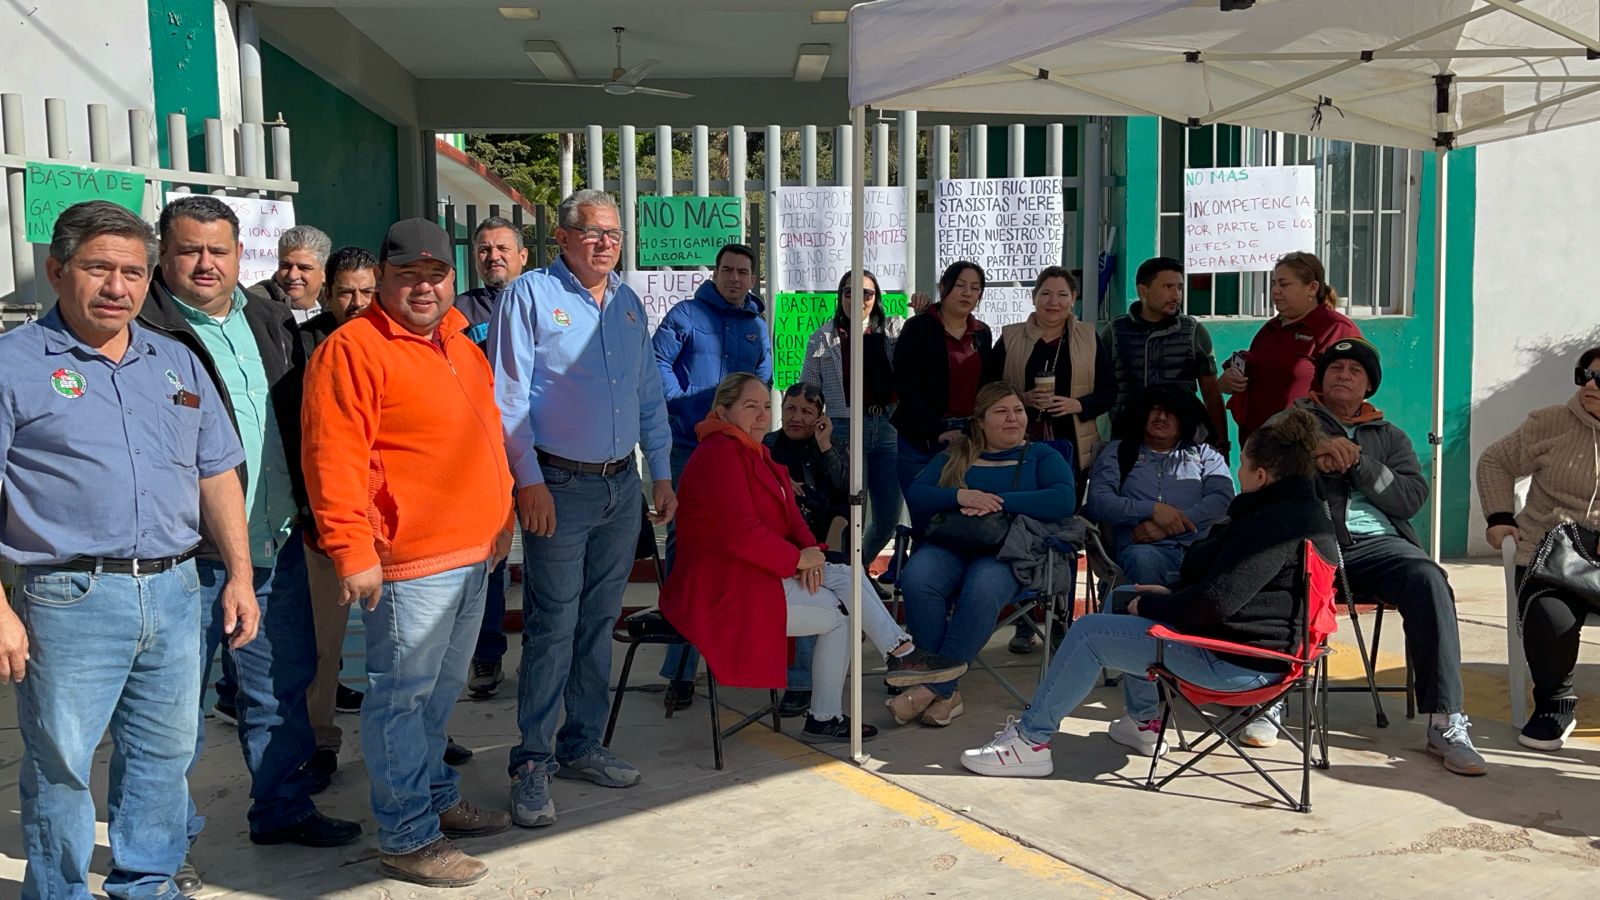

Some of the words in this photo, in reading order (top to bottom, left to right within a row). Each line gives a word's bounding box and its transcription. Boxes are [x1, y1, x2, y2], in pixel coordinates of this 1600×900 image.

[28, 165, 100, 193] BASTA
[106, 174, 133, 190] DE
[1186, 170, 1203, 186] NO
[1210, 169, 1249, 184] MAS
[940, 181, 962, 196] LOS
[970, 179, 1062, 195] INSTRUCTORES
[783, 191, 839, 209] NUESTRO
[843, 190, 893, 206] PNTEL
[940, 197, 1010, 213] STASISTAS
[1189, 195, 1310, 218] INCOMPETENCIA
[260, 204, 279, 215] LA
[780, 212, 817, 229] TIENE
[824, 210, 882, 229] SOLICUD
[889, 212, 907, 228] DE
[939, 214, 986, 227] CEMOS
[996, 213, 1018, 226] QUE
[1023, 213, 1039, 226] SE
[1187, 224, 1211, 236] POR
[1217, 221, 1259, 235] PARTE
[1268, 220, 1286, 231] DE
[1293, 219, 1312, 229] LOS
[779, 230, 835, 249] CAMBIOS
[840, 231, 847, 246] Y
[861, 228, 907, 246] RAMITES
[939, 228, 979, 242] PETEN
[985, 226, 1044, 241] NUESTROS
[940, 243, 984, 256] RECHOS
[991, 243, 997, 256] Y
[1002, 242, 1037, 254] TRATO
[1188, 242, 1230, 253] JEFES
[1237, 240, 1259, 249] DE
[644, 251, 702, 261] LABORAL
[808, 250, 823, 264] NO
[828, 248, 845, 262] SE
[986, 256, 1020, 267] PARTE
[1023, 257, 1036, 266] DE
[1040, 255, 1058, 265] LOS
[1187, 254, 1285, 267] DEPARTAME
[648, 273, 713, 294] FUER
[783, 266, 837, 285] TOMADO
[1013, 288, 1033, 300] STA
[781, 297, 828, 313] BASTA
[985, 302, 1007, 312] PAGO
[1013, 301, 1024, 312] DE
[779, 316, 787, 332] Y
[777, 334, 804, 350] CON
